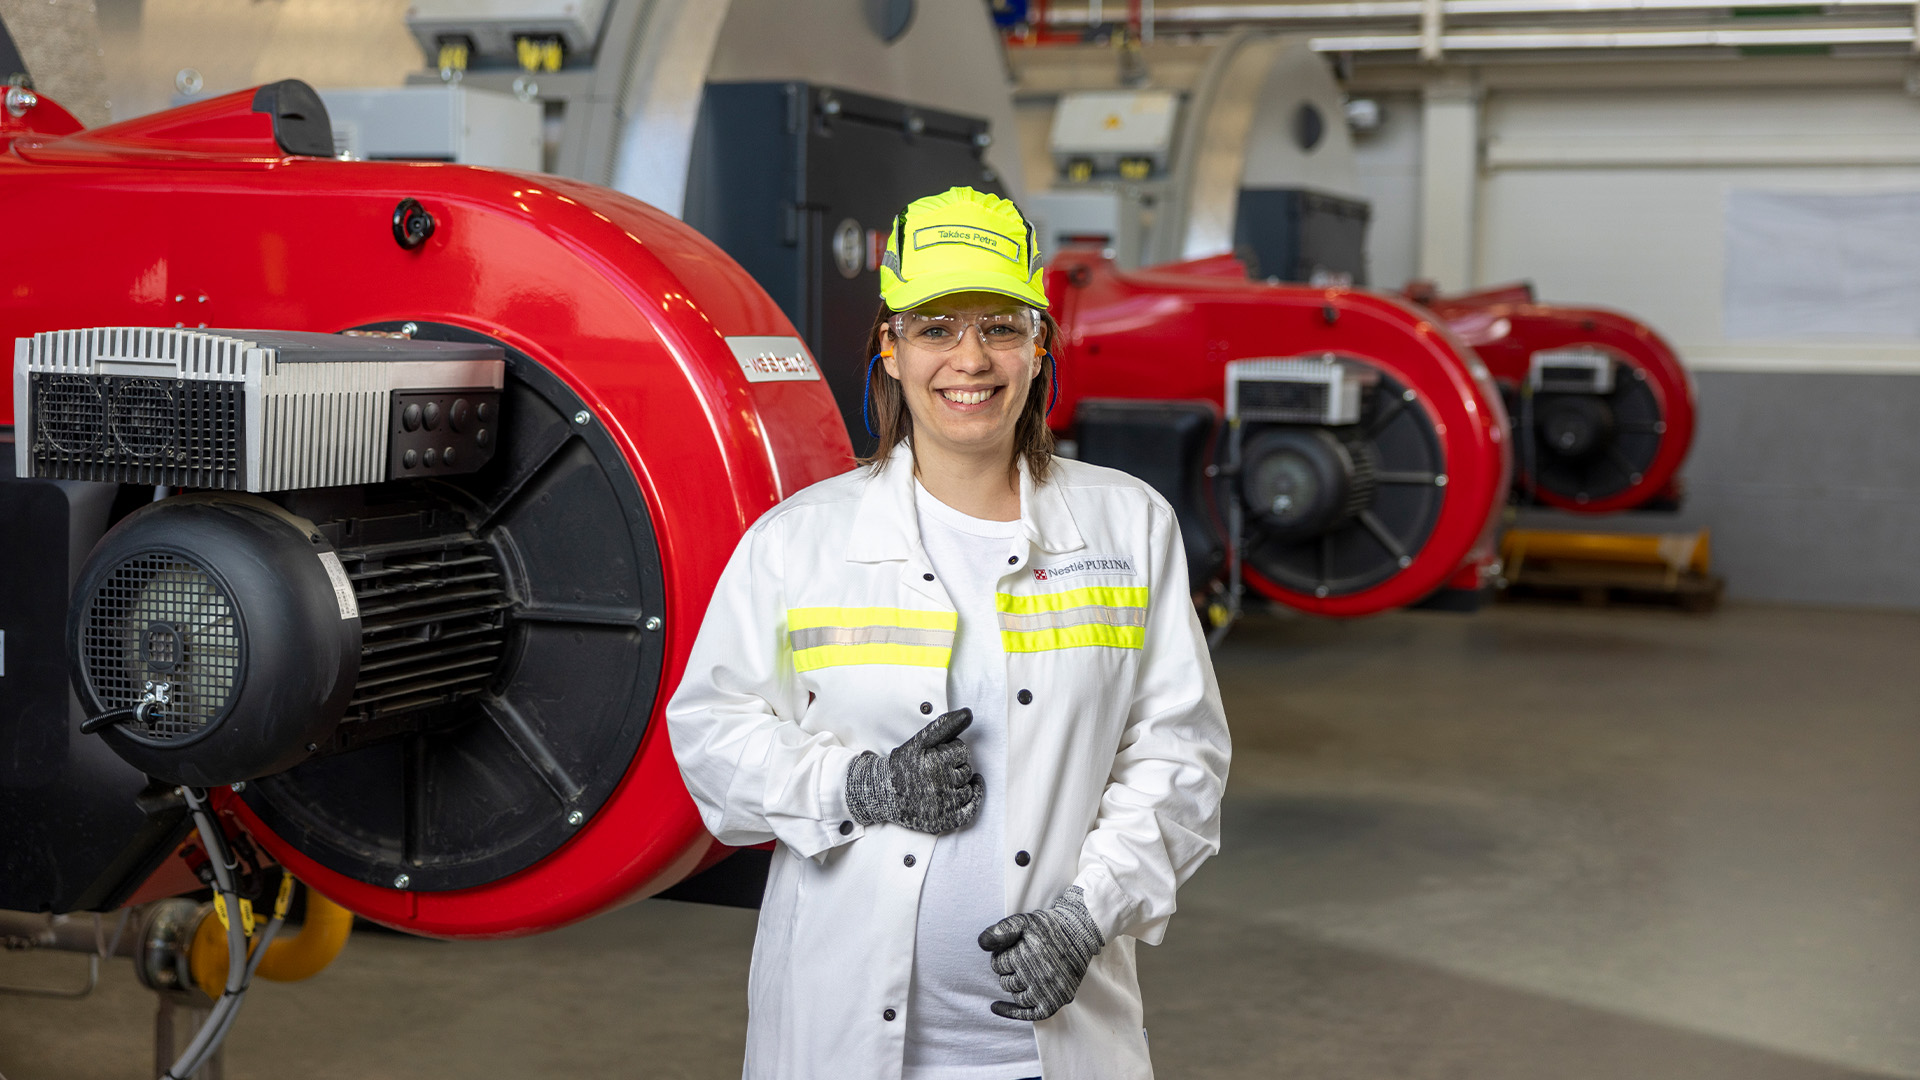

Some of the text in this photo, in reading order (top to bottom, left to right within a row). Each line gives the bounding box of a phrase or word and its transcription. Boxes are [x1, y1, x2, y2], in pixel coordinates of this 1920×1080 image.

[938, 230, 998, 247] Takács Petra
[1048, 559, 1131, 578] Nestlé PURINA
